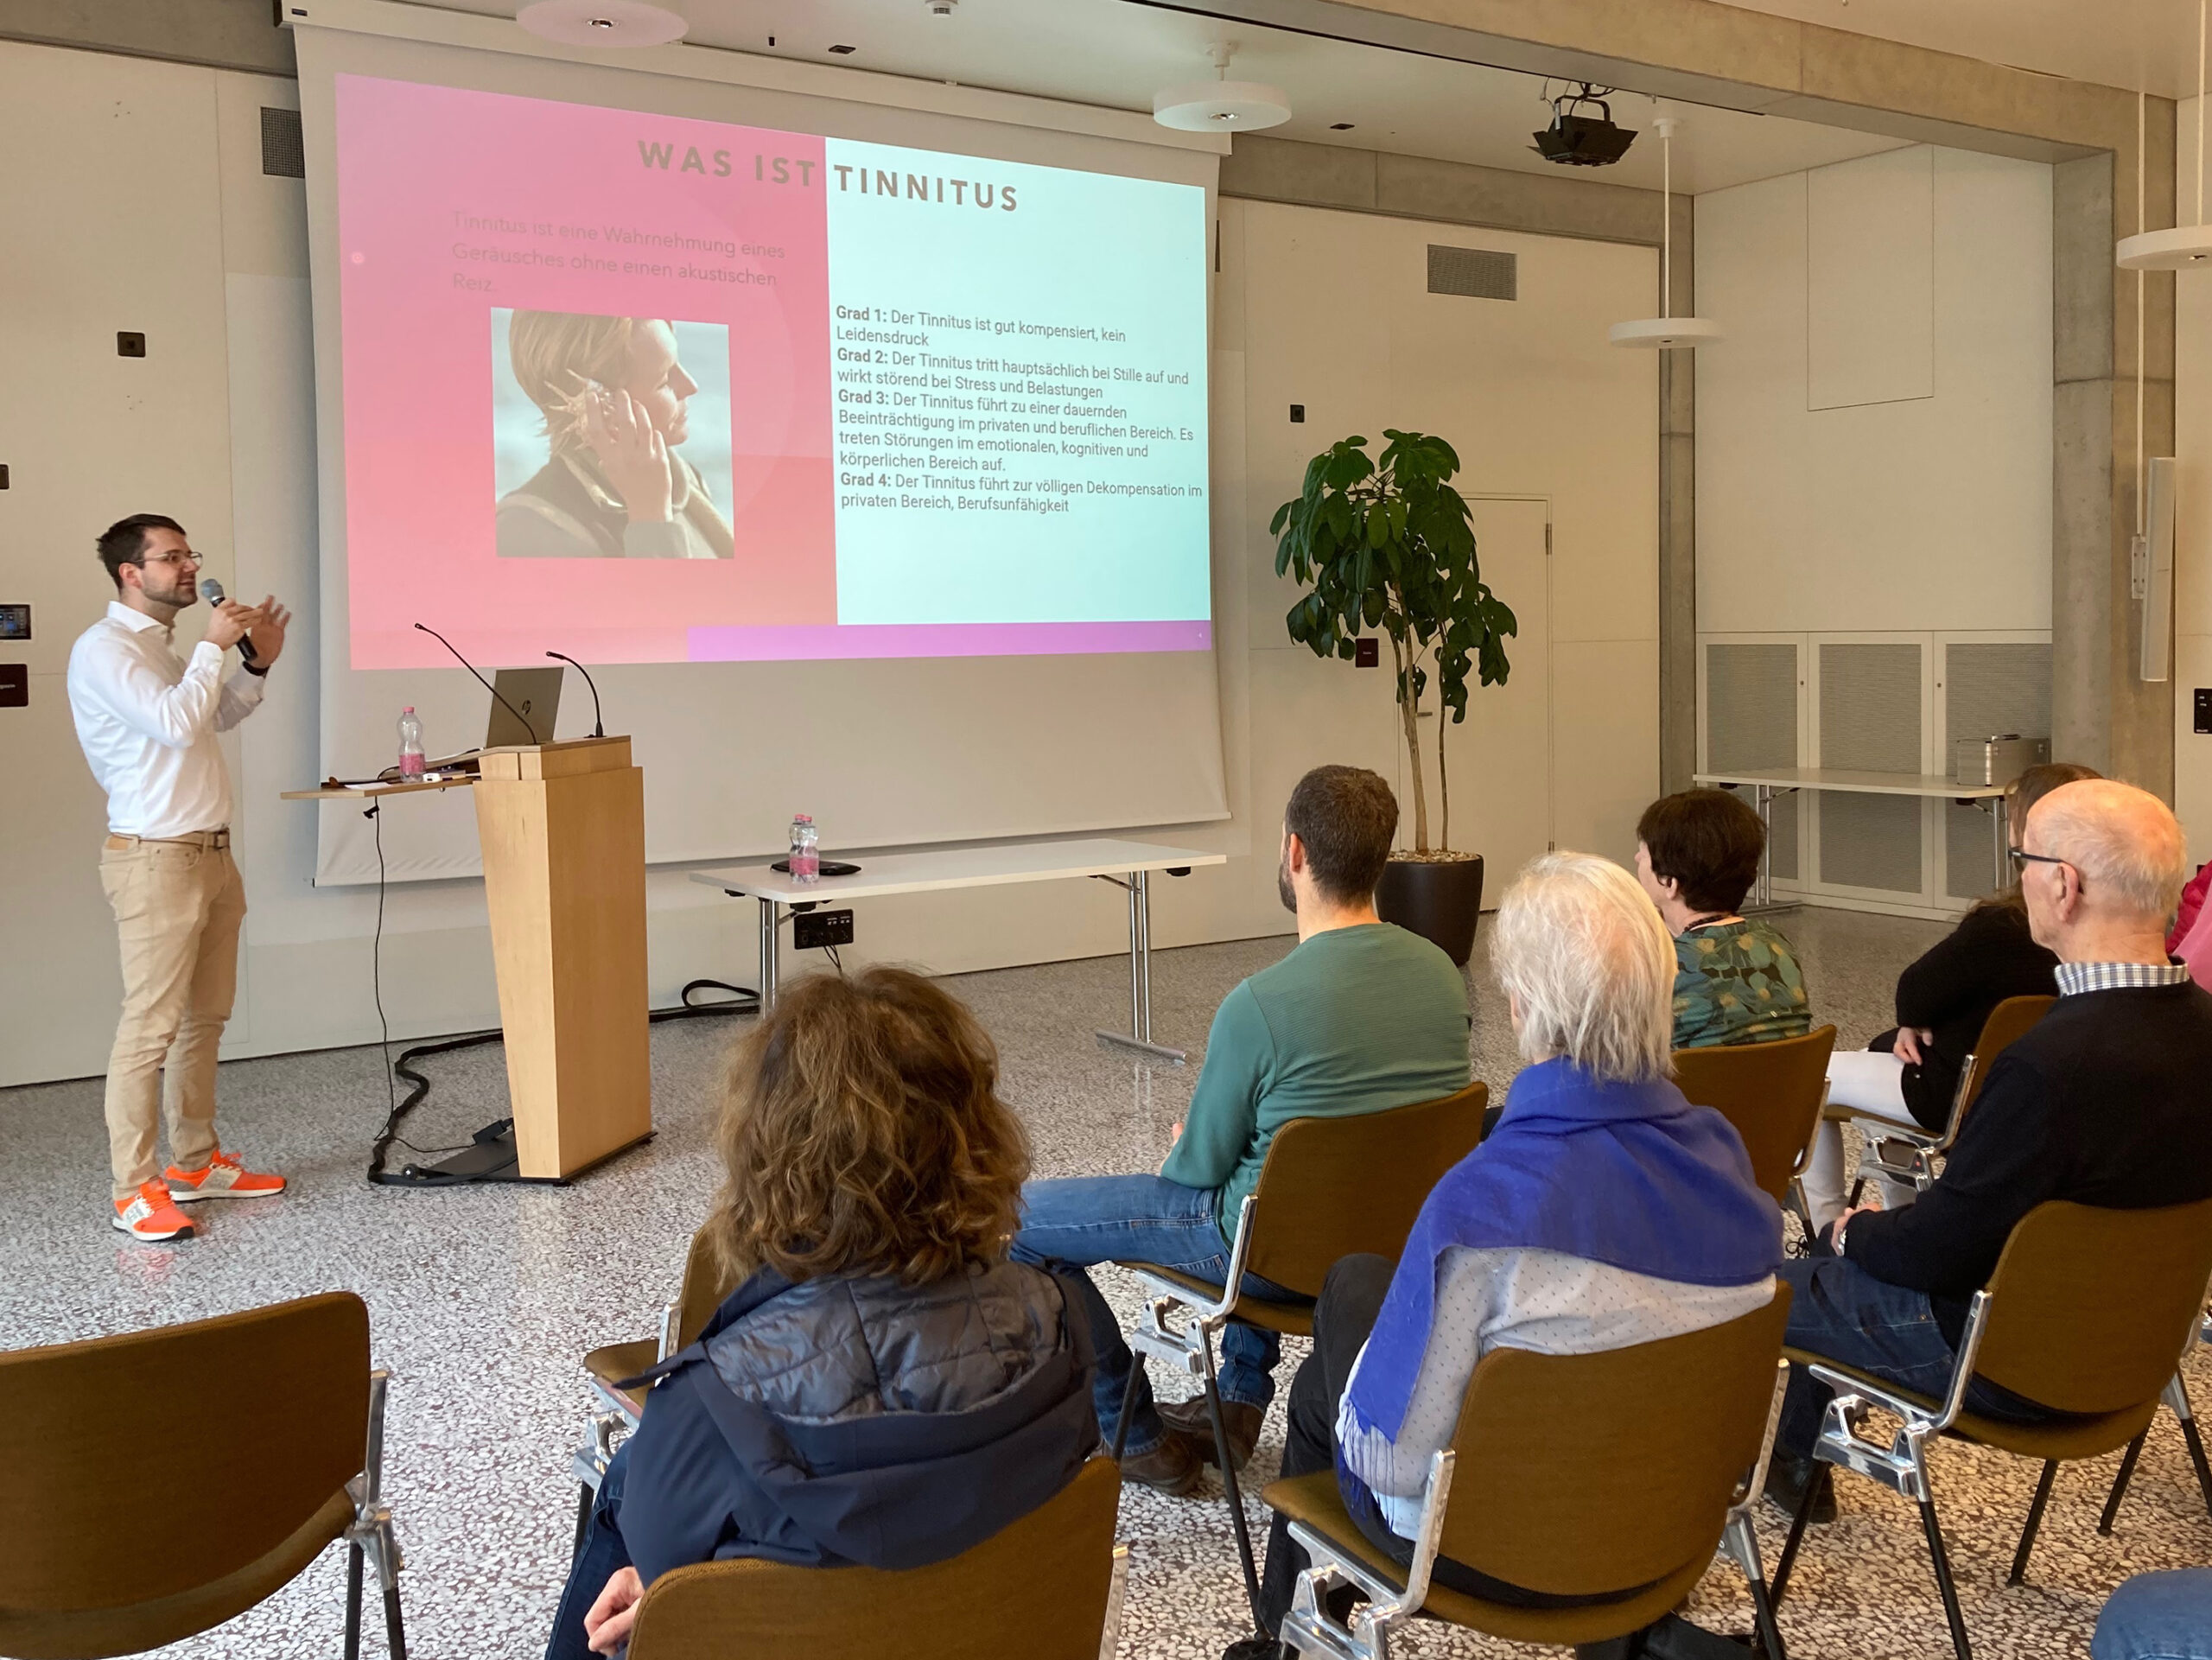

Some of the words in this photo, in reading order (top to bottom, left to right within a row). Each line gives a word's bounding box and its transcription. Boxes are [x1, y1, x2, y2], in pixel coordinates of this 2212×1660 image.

[638, 140, 732, 177] WAS
[755, 155, 815, 187] IST
[834, 165, 1017, 211] TINNITUS
[453, 210, 527, 233] Tinnitus
[533, 222, 554, 236] ist
[559, 225, 598, 240] eine
[603, 226, 735, 258] Wahrnehmung
[741, 240, 785, 258] eines
[453, 243, 564, 268] Geräusches
[570, 252, 618, 271] ohne
[623, 261, 672, 277] einen
[678, 263, 777, 286] akustischen
[836, 305, 870, 321] Grad
[874, 308, 887, 322] 1:
[891, 309, 914, 325] Der
[918, 312, 972, 329] Tinnitus
[976, 317, 991, 331] ist
[995, 318, 1015, 335] gut
[1019, 321, 1098, 342] kompensiert,
[1102, 328, 1126, 342] kein
[836, 326, 929, 347] Leidensdruck
[837, 347, 871, 363] Grad
[874, 350, 888, 364] 2:
[893, 351, 916, 366] Der
[918, 353, 973, 370] Tinnitus
[976, 358, 999, 372] tritt
[1002, 359, 1089, 378] hauptsächlich
[1092, 365, 1110, 380] bei
[1113, 367, 1142, 383] Stille
[1146, 370, 1164, 384] auf
[1167, 372, 1189, 385] und
[837, 369, 872, 384] wirkt
[876, 372, 928, 388] störend
[931, 373, 951, 389] bei
[955, 376, 996, 391] Stress
[1000, 380, 1023, 394] und
[1027, 381, 1103, 400] Belastungen
[838, 389, 872, 404] Grad
[876, 391, 889, 405] 3:
[893, 391, 917, 407] Der
[920, 393, 974, 410] Tinnitus
[977, 397, 1008, 413] führt
[1011, 402, 1026, 413] zu
[1029, 401, 1061, 415] einer
[1063, 402, 1127, 419] dauernden
[839, 410, 955, 432] Beeinträchtigung
[958, 416, 975, 430] im
[979, 418, 1030, 434] privaten
[1033, 421, 1057, 434] und
[1060, 422, 1127, 437] beruflichen
[1130, 425, 1176, 441] Bereich.
[1180, 428, 1193, 441] Es
[839, 431, 880, 445] treten
[884, 433, 954, 451] Störungen
[957, 436, 974, 450] im
[977, 438, 1058, 456] emotionalen,
[1062, 441, 1123, 458] kognitiven
[1127, 445, 1148, 457] und
[840, 450, 925, 469] körperlichen
[929, 455, 978, 470] Bereich
[982, 457, 1006, 472] auf.
[841, 472, 874, 487] Grad
[878, 474, 892, 487] 4:
[895, 474, 918, 488] Der
[922, 474, 976, 490] Tinnitus
[979, 476, 1010, 492] führt
[1013, 480, 1033, 492] zur
[1036, 480, 1084, 496] völligen
[1087, 480, 1185, 498] Dekompensation
[1188, 484, 1202, 497] im
[841, 493, 897, 509] privaten
[901, 494, 954, 512] Bereich,
[958, 495, 1069, 514] Berufsunfähigkeit
